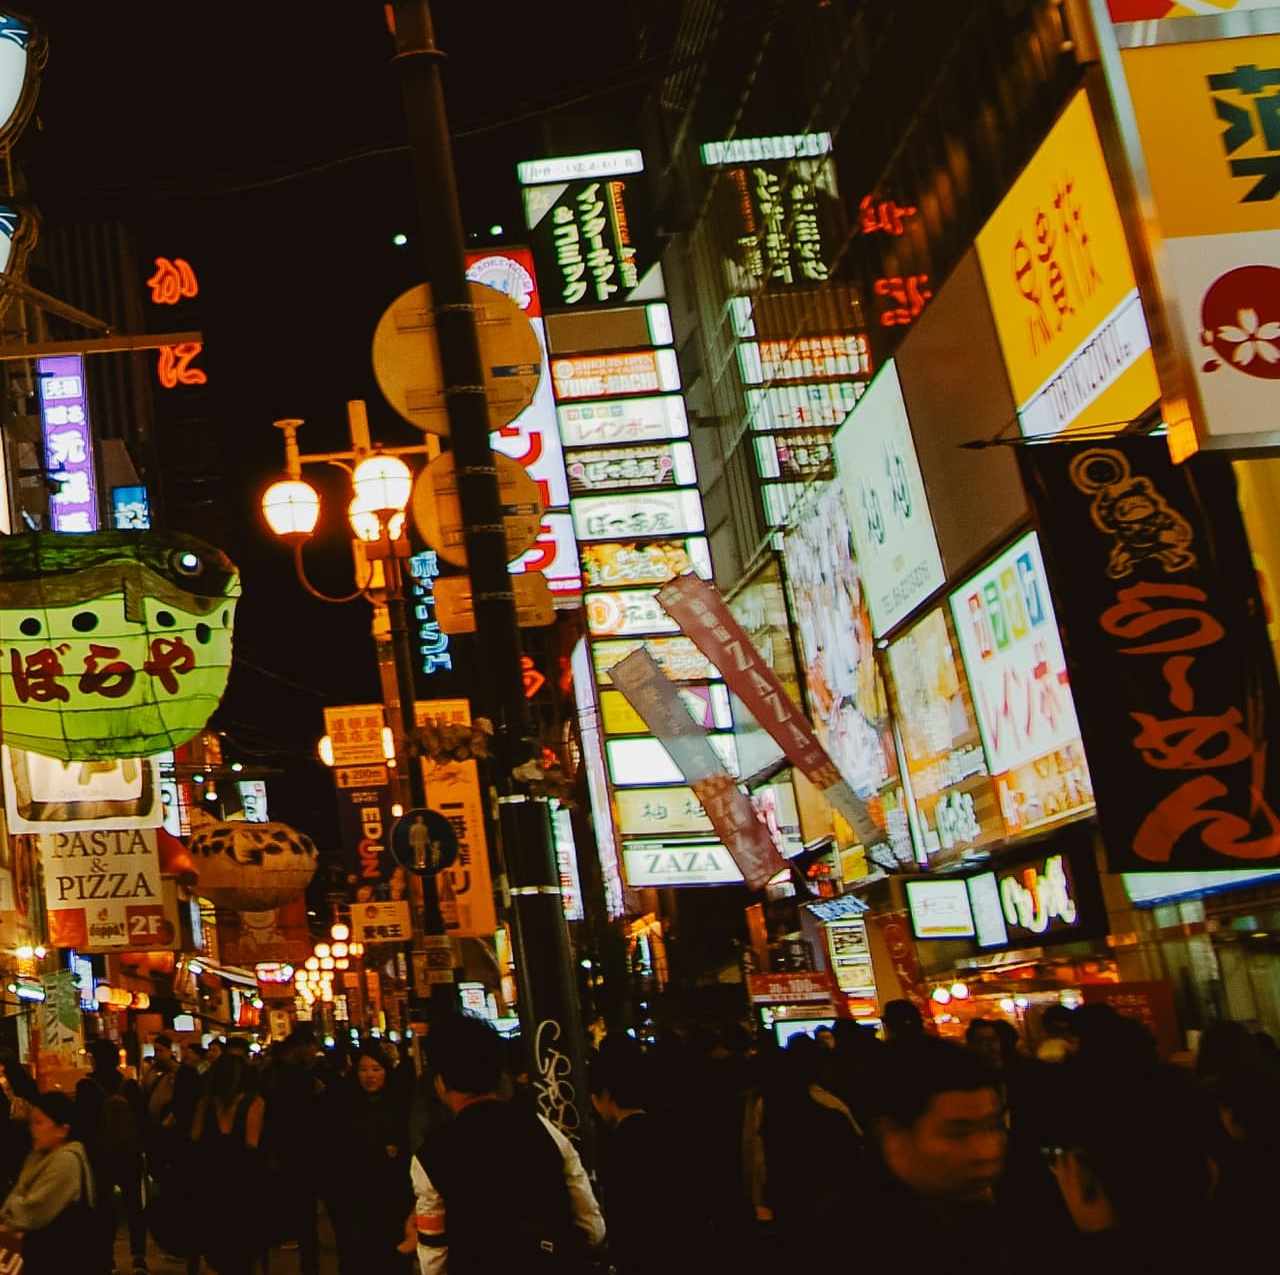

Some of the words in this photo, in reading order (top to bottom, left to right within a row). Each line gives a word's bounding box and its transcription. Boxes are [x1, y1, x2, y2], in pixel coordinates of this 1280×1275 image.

[8, 636, 197, 704] ぼらや
[1097, 579, 1280, 863] らーめん
[52, 829, 152, 859] PASTA
[90, 858, 109, 873] &
[645, 851, 722, 875] ZAZA
[56, 872, 156, 901] PIZZA
[130, 915, 164, 936] 2F
